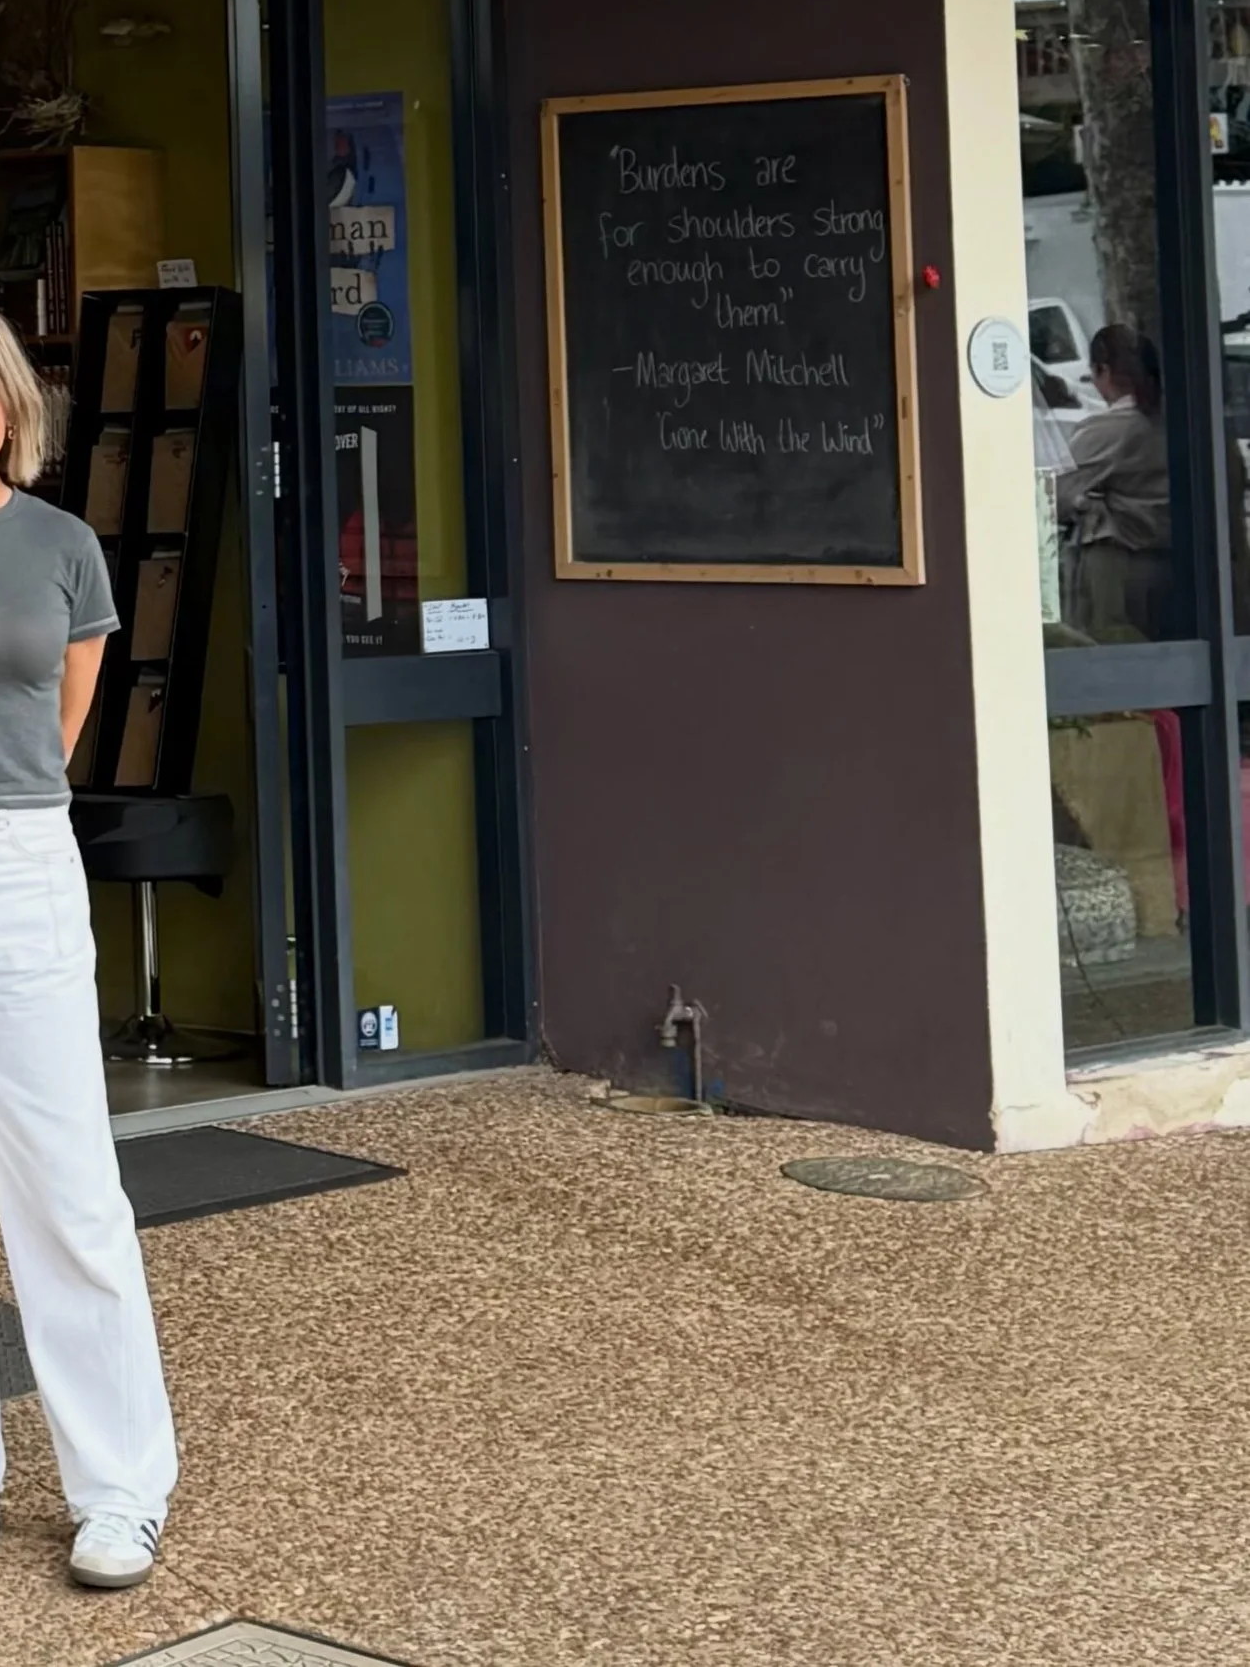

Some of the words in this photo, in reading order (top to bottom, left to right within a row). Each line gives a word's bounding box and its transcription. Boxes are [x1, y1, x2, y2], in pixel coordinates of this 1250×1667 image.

[755, 153, 798, 186] are
[599, 210, 645, 261] for
[667, 205, 795, 244] shoulders
[813, 199, 886, 263] strong
[626, 251, 724, 309] enough
[749, 247, 781, 280] to
[804, 252, 866, 303] carry
[746, 348, 849, 389] Mitchell
[779, 416, 811, 454] the
